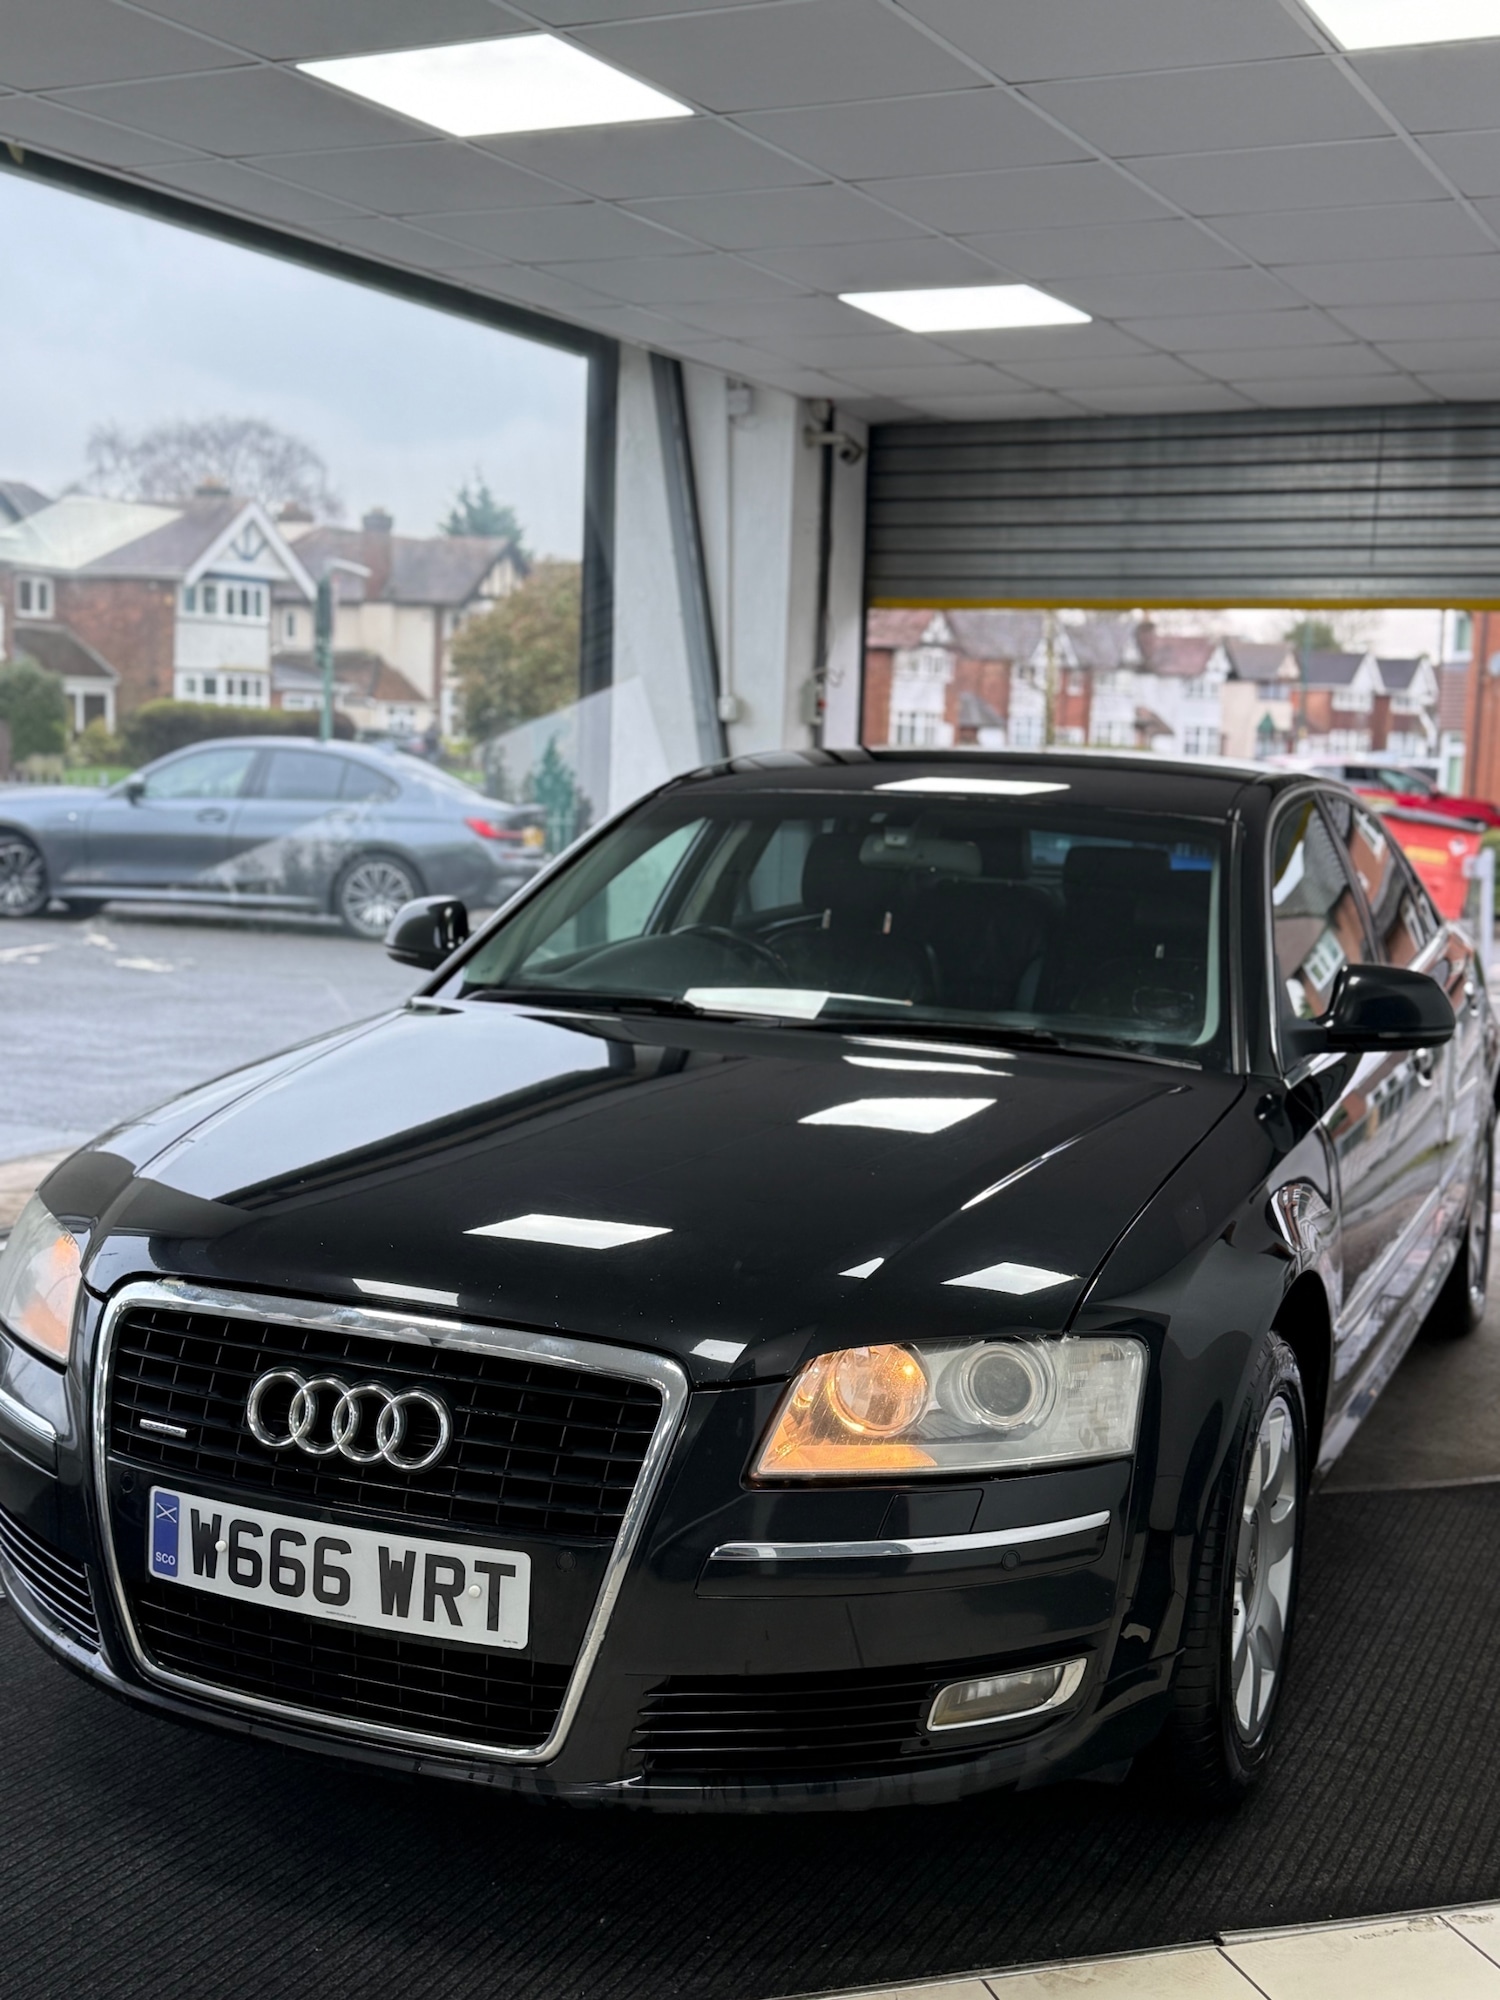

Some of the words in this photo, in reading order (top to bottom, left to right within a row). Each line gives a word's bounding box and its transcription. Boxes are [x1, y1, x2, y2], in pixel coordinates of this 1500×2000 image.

[155, 1551, 176, 1566] SCO
[190, 1508, 352, 1607] W666
[378, 1546, 516, 1632] WRT
